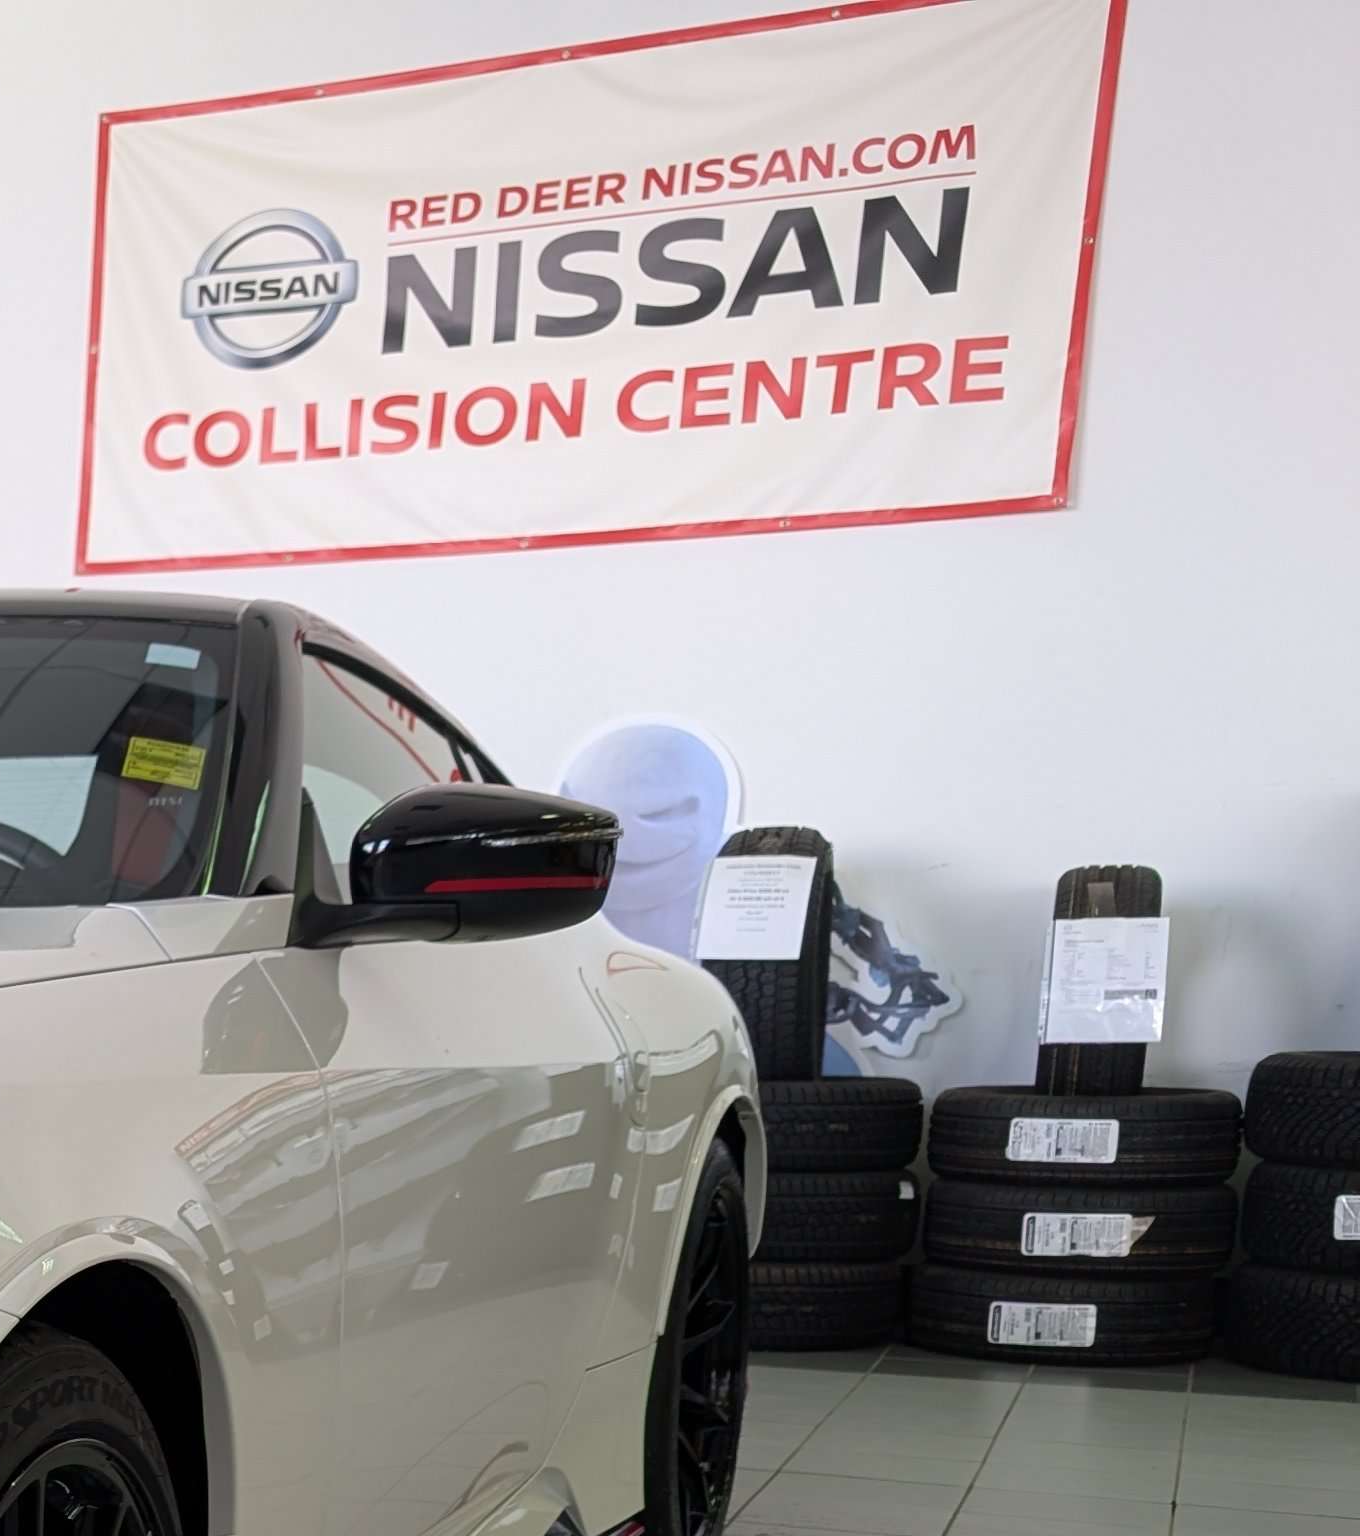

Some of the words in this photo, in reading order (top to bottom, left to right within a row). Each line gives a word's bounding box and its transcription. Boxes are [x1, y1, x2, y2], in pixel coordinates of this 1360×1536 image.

[387, 190, 483, 232] RED
[495, 175, 629, 220] DEER
[640, 122, 977, 199] NISSAN.COM
[197, 271, 340, 309] NISSAN
[381, 186, 971, 354] NISSAN
[141, 376, 588, 472] COLLISION
[614, 334, 1010, 434] CENTRE
